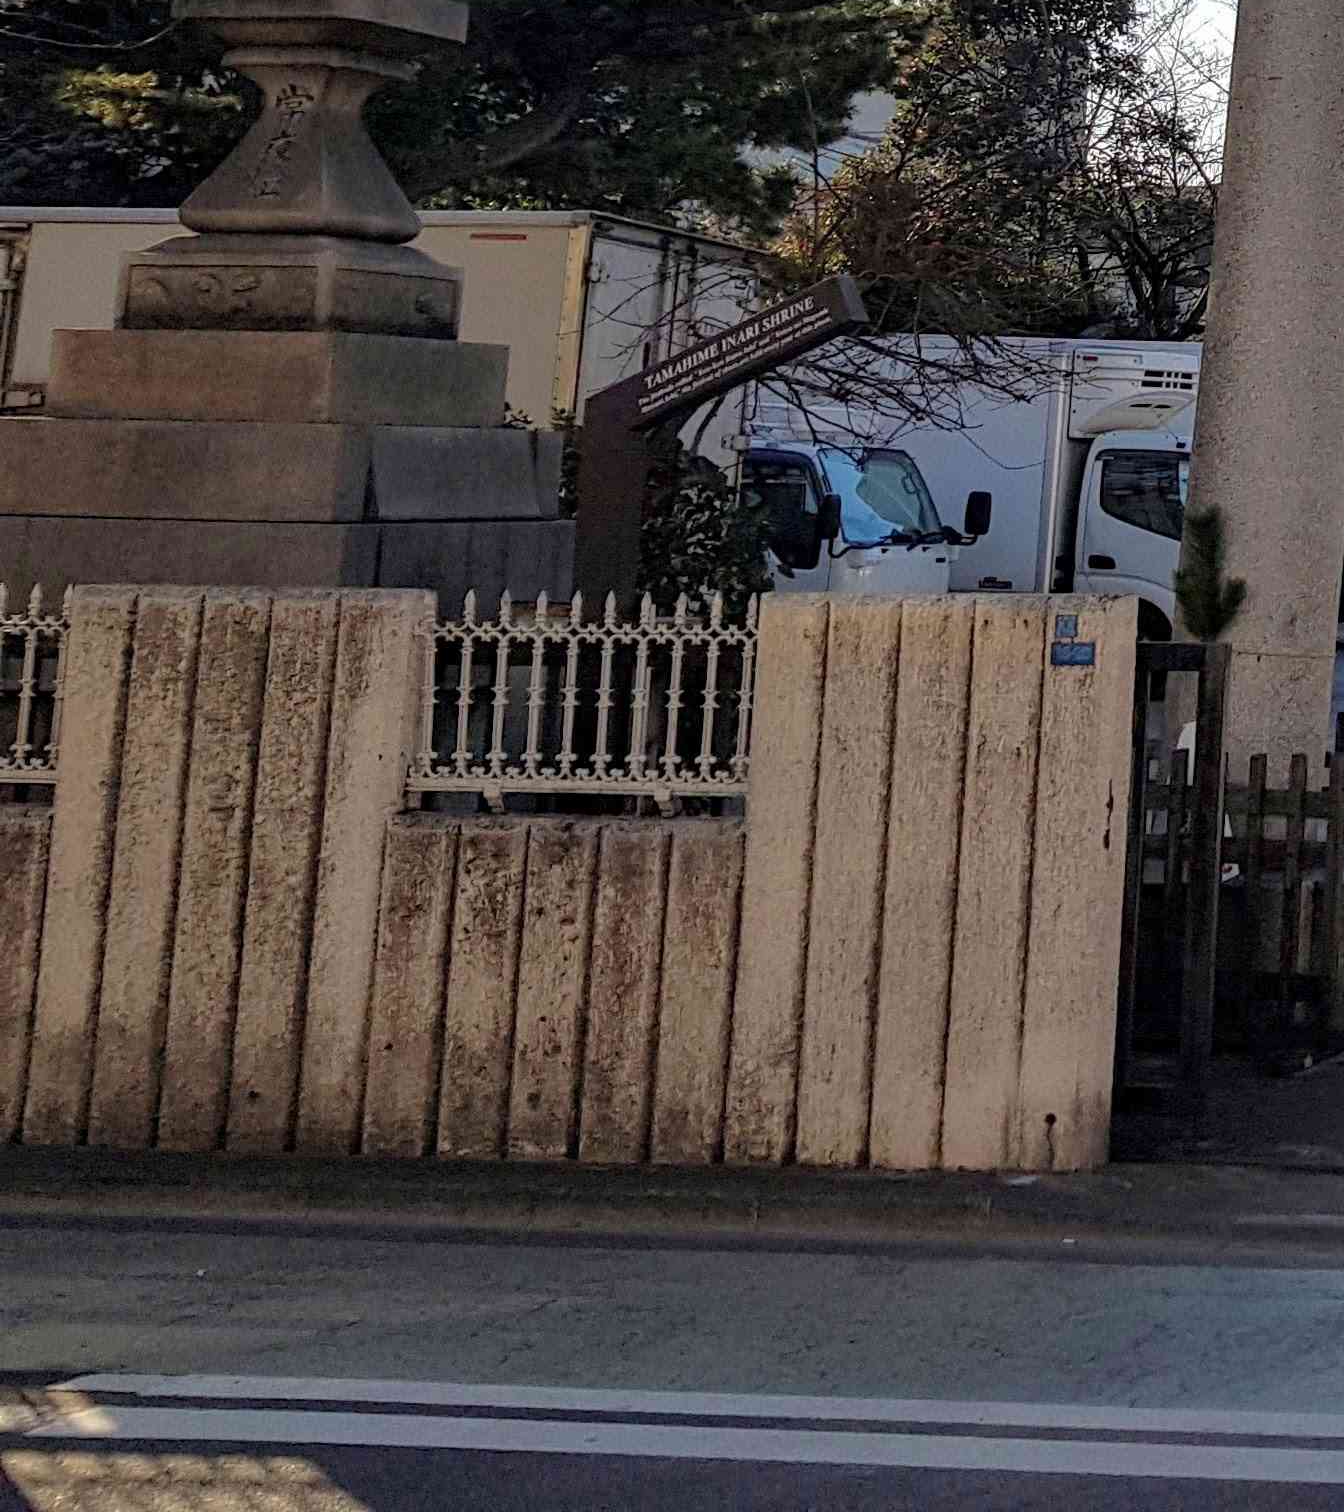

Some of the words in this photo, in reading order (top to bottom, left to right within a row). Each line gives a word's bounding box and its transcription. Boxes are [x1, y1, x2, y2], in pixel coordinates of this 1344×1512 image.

[643, 342, 720, 389] TAMAHIME
[721, 321, 761, 353] INARI
[761, 295, 815, 333] SHRINE
